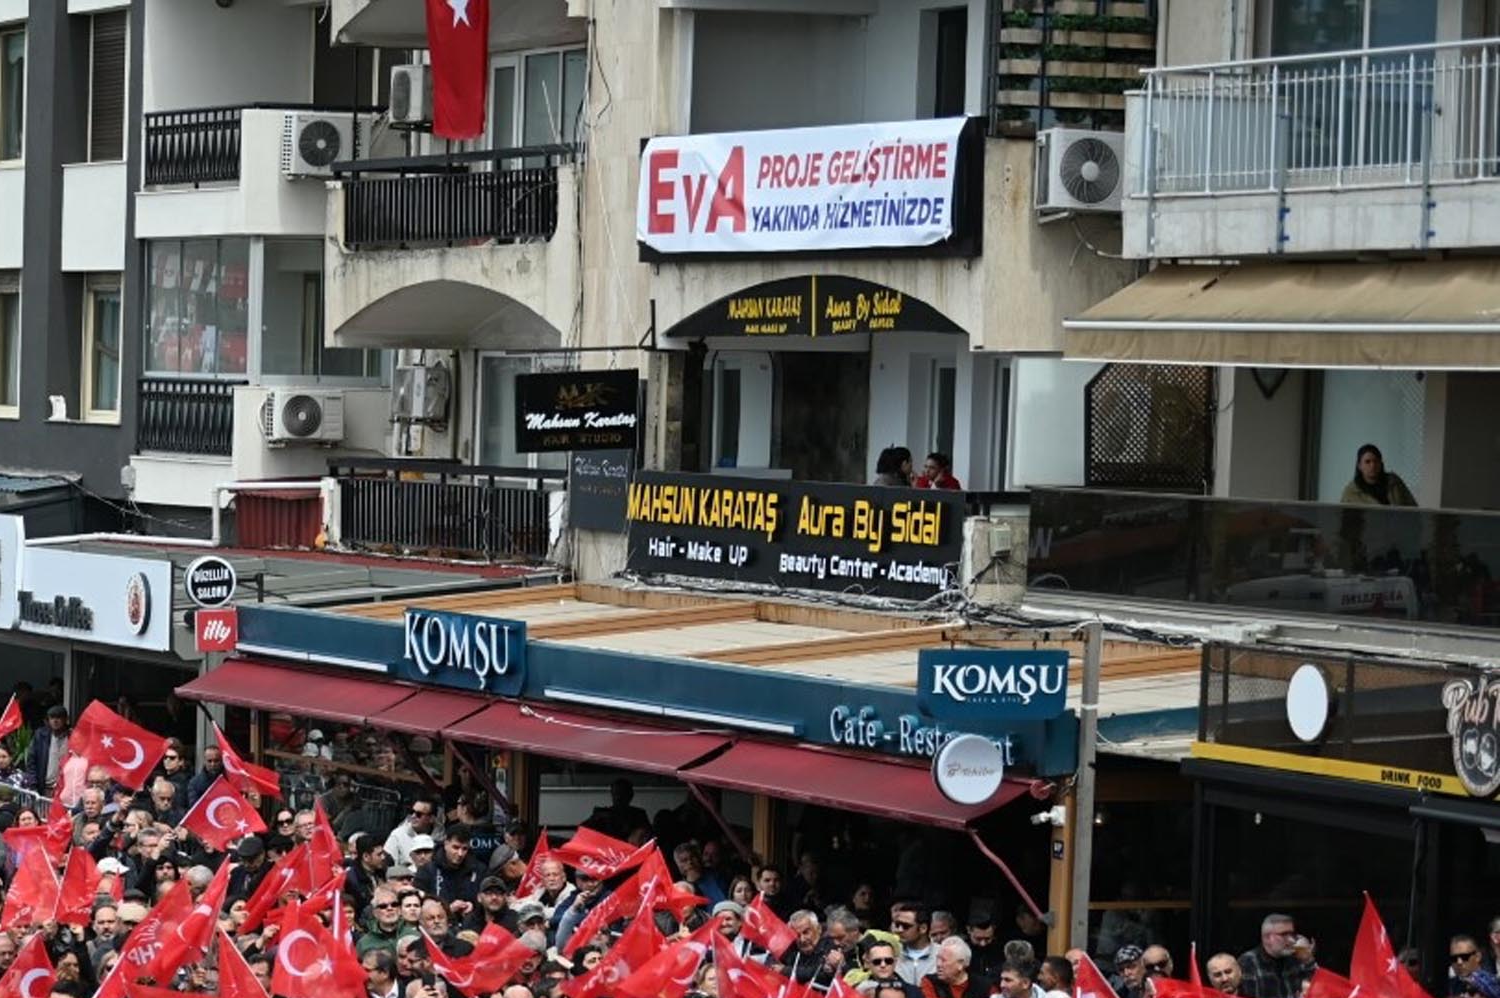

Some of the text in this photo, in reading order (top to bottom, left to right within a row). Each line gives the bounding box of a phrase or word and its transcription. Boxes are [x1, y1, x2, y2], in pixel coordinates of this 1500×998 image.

[756, 138, 949, 189] PROJE GELİŞTİRME
[751, 190, 945, 232] YAKINDA HİZMETİNİZDE
[825, 295, 851, 318] Aura
[856, 293, 871, 321] By
[525, 412, 580, 430] Mahsun
[627, 482, 779, 543] MAHSUN KARATAŞ
[797, 496, 941, 552] Aura By Sidal
[648, 536, 677, 559] Hair
[687, 541, 722, 564] Make
[779, 553, 827, 579] Beauty
[830, 555, 877, 580] Center
[887, 561, 948, 590] Academy
[203, 619, 232, 645] illy
[404, 612, 510, 690] KOMŞU
[932, 664, 1065, 704] KOMŞU
[830, 705, 877, 747] Cafe
[1442, 675, 1490, 736] Pub
[1380, 769, 1442, 790] DRINK FOOD
